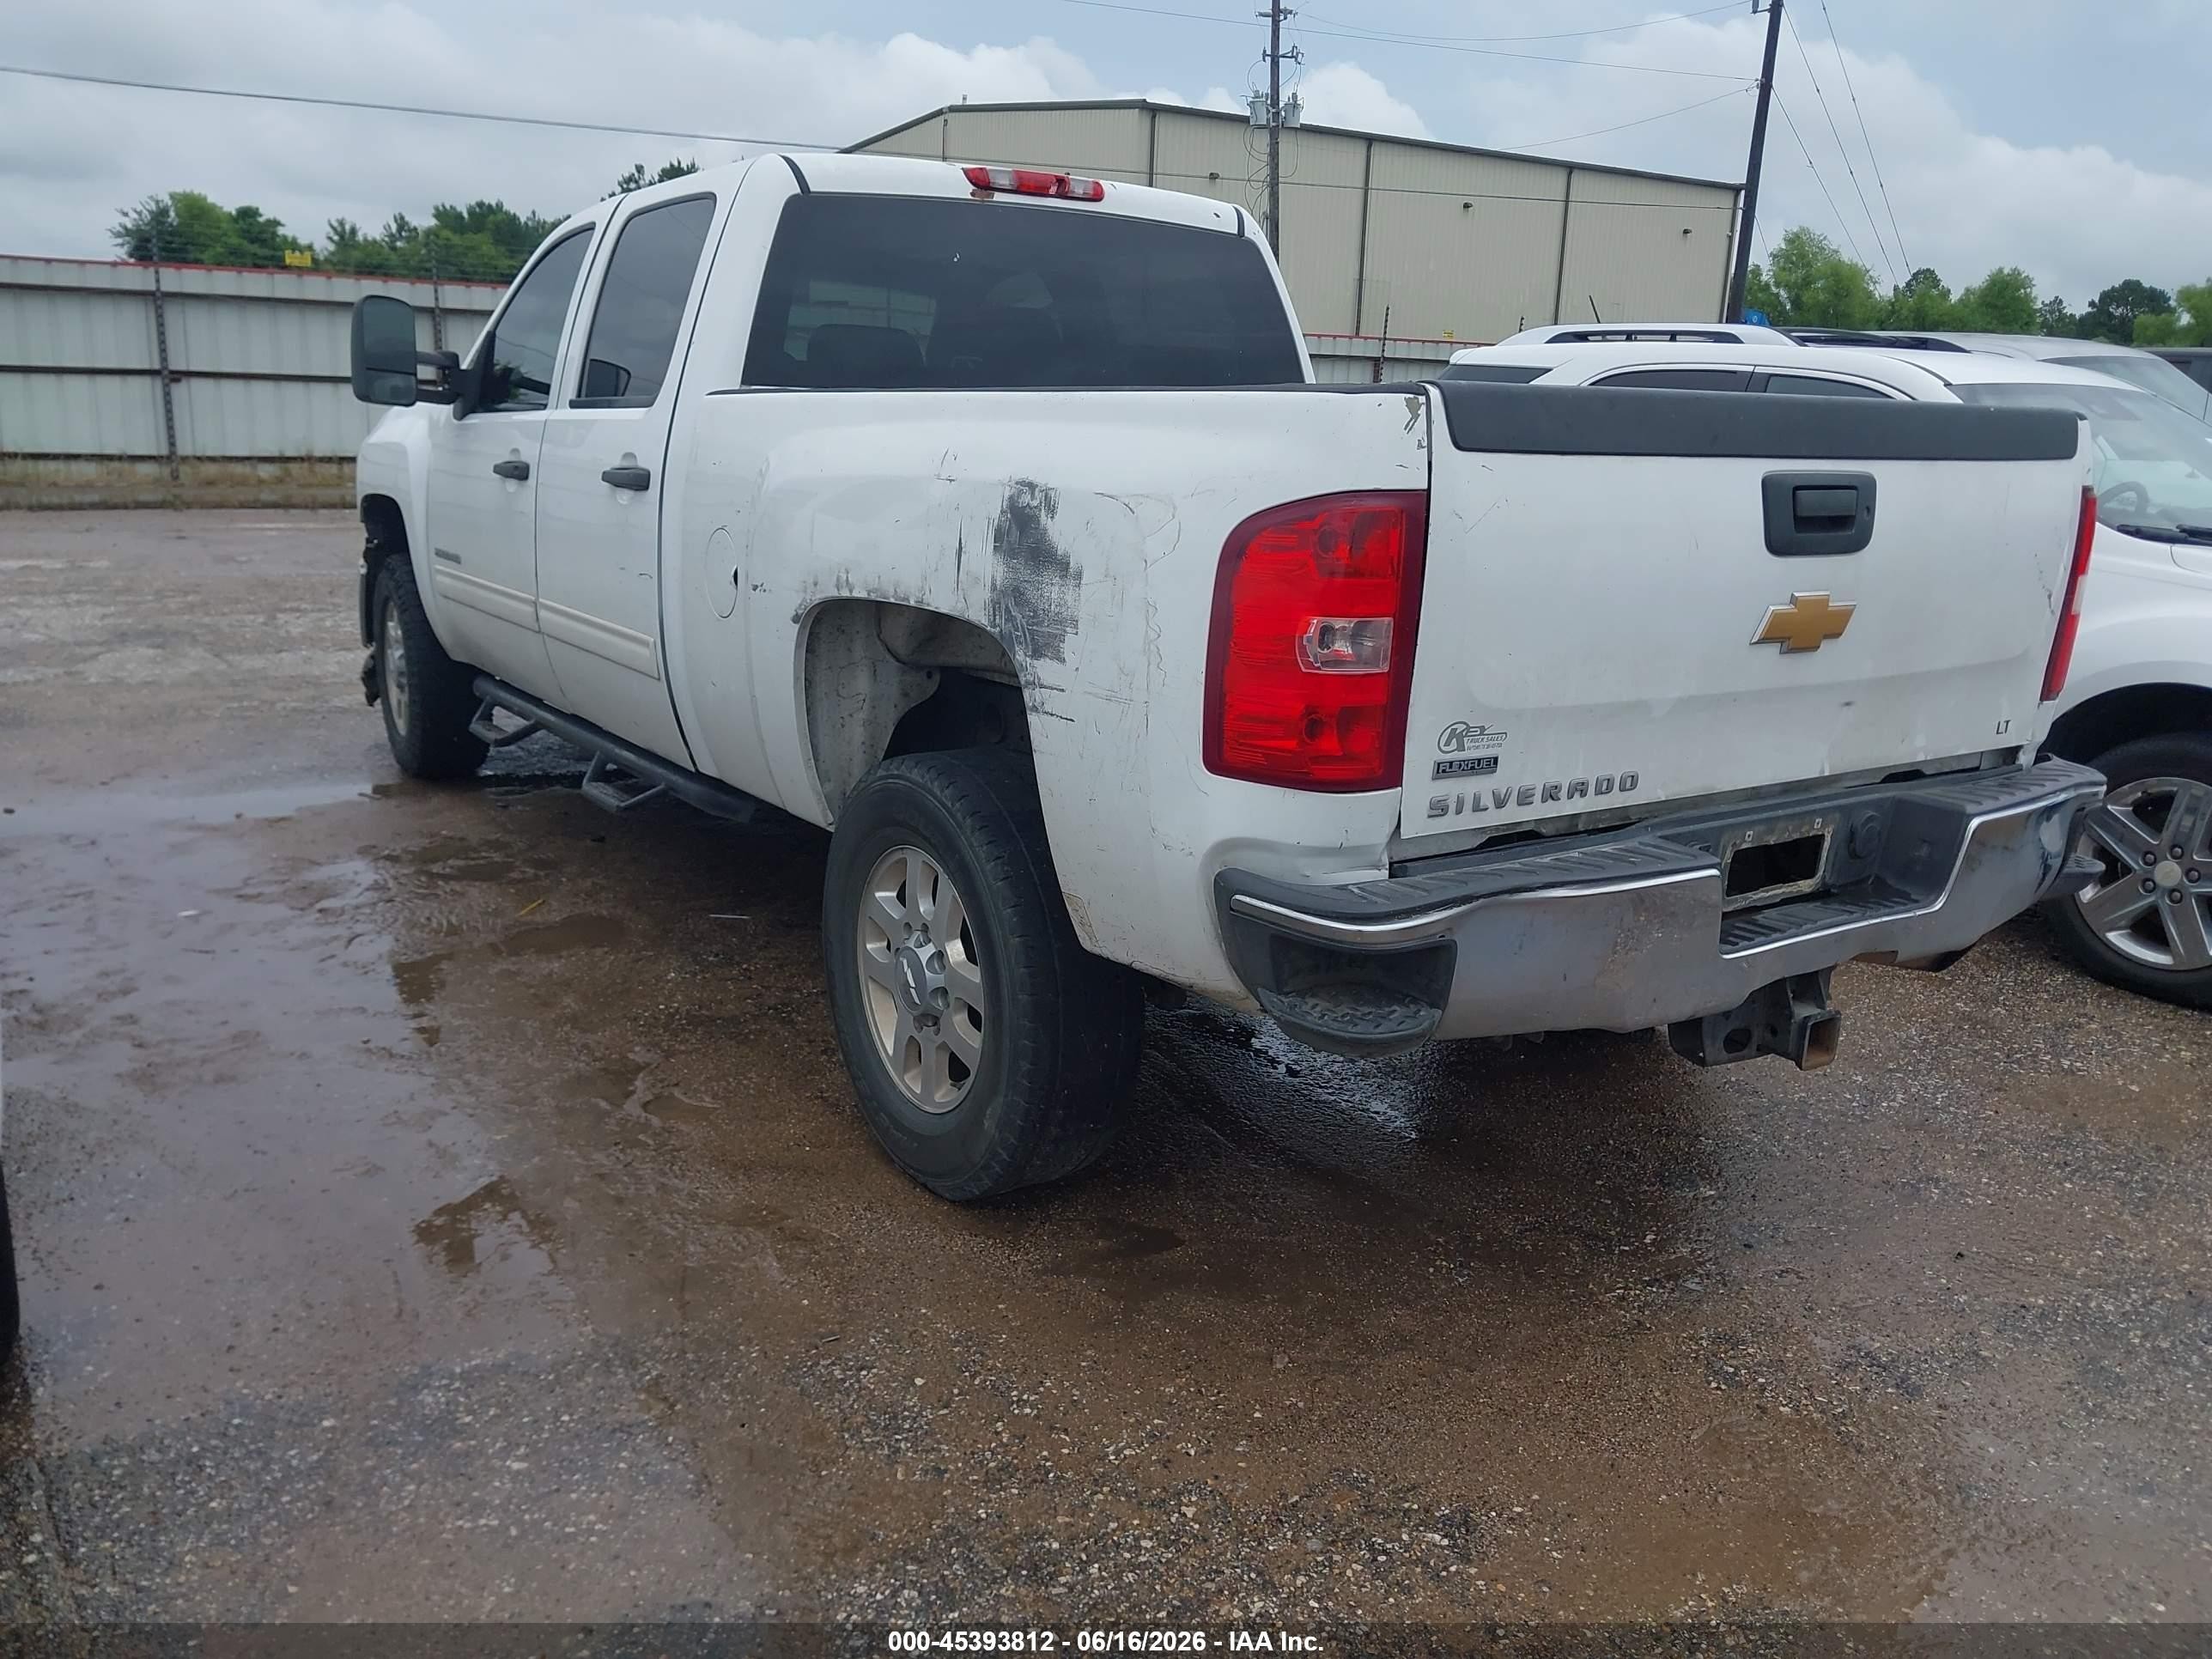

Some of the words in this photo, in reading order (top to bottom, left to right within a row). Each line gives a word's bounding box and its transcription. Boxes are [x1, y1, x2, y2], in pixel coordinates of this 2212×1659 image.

[1996, 720, 2011, 735] LT
[1437, 757, 1497, 774] FLEXFUEL
[1427, 770, 1639, 818] SILVERADO
